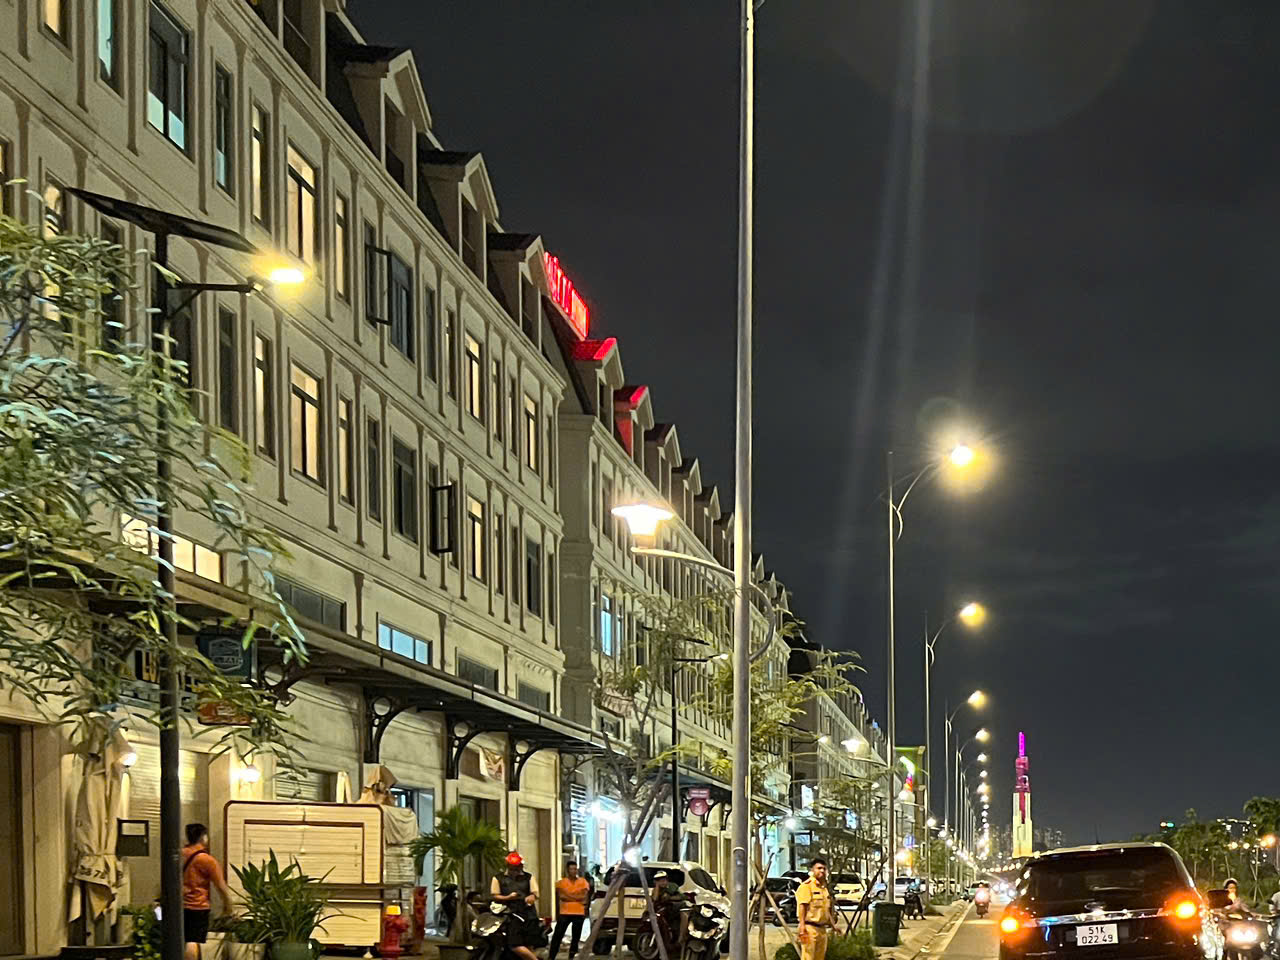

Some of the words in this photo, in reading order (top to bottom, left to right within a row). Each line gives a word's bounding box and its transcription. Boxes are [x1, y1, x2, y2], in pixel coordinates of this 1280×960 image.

[1088, 926, 1105, 935] 51K
[1081, 935, 1099, 944] 022
[1102, 934, 1114, 943] 49
